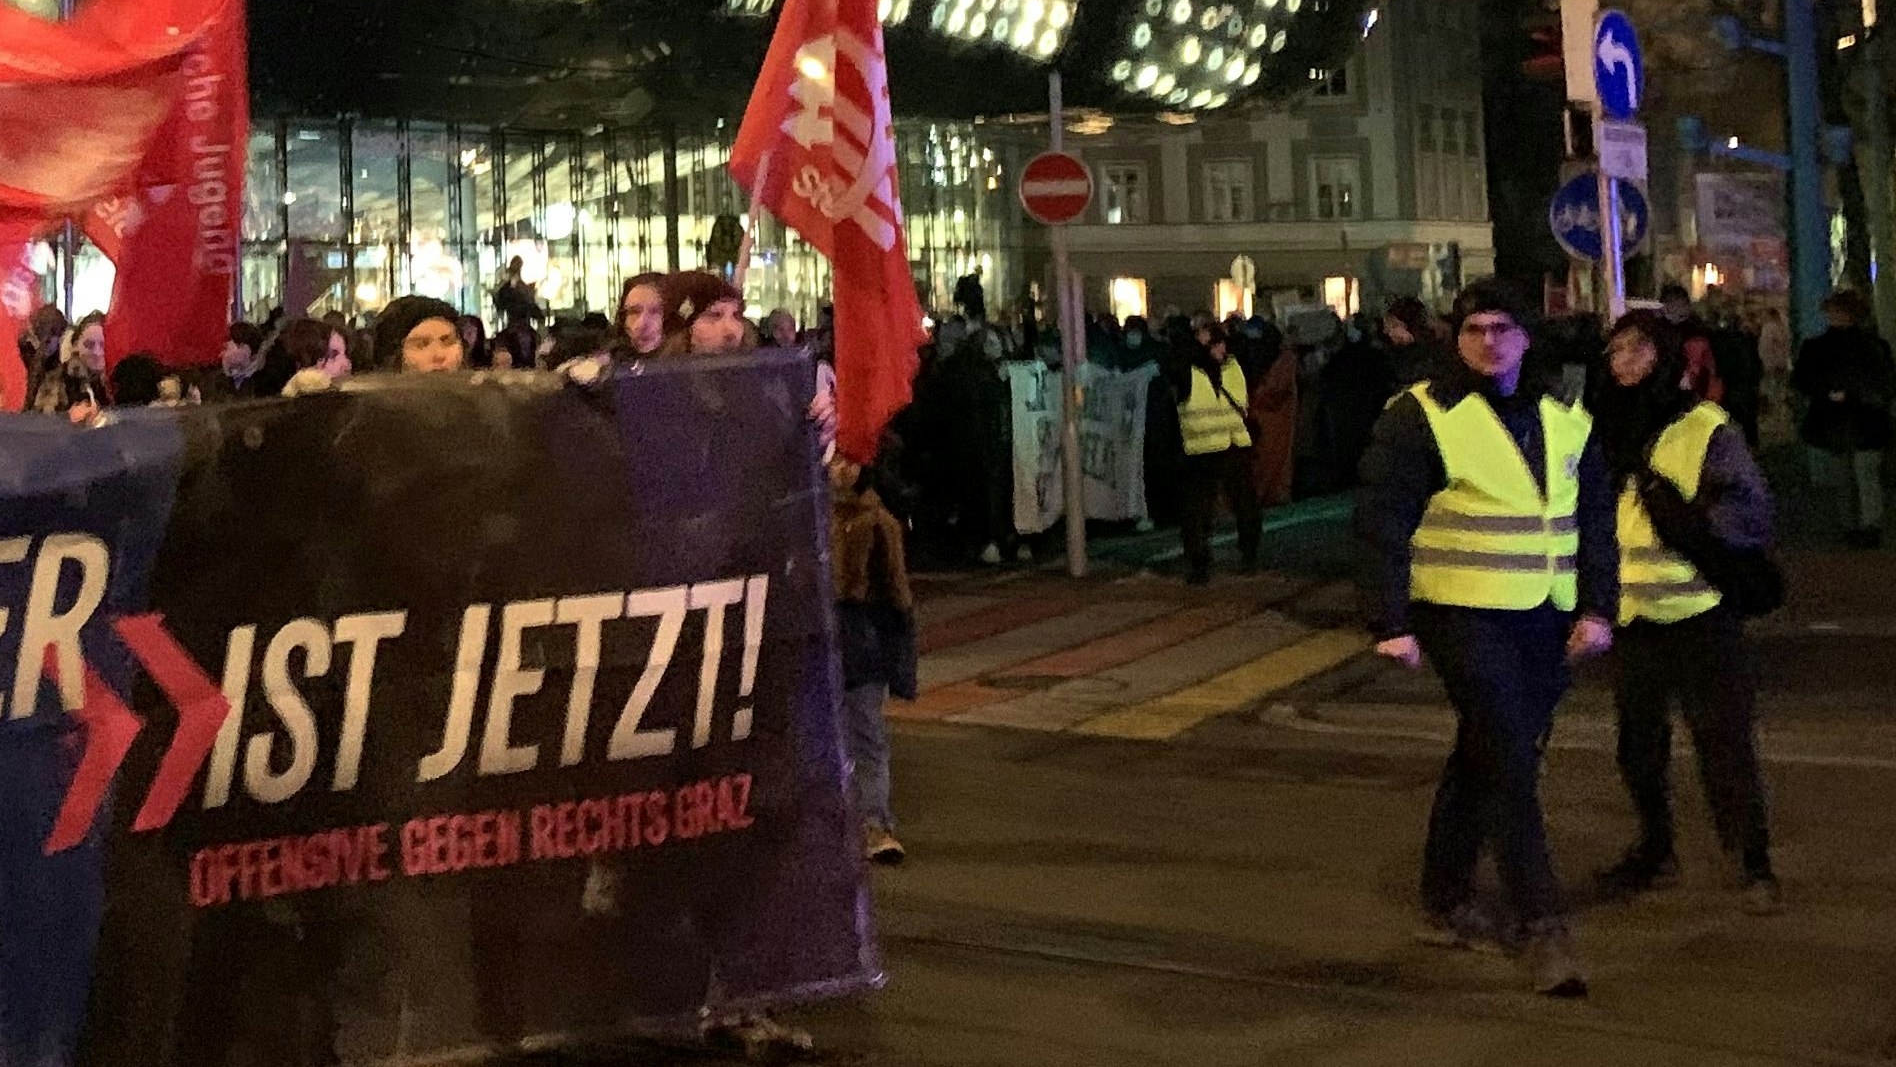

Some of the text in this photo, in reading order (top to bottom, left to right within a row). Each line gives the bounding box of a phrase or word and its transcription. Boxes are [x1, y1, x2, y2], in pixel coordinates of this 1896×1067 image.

[202, 607, 408, 810] IST
[416, 574, 769, 782] JETZT!
[189, 773, 755, 907] OFFENSIVE GEGEN RECHTS GRAZ
